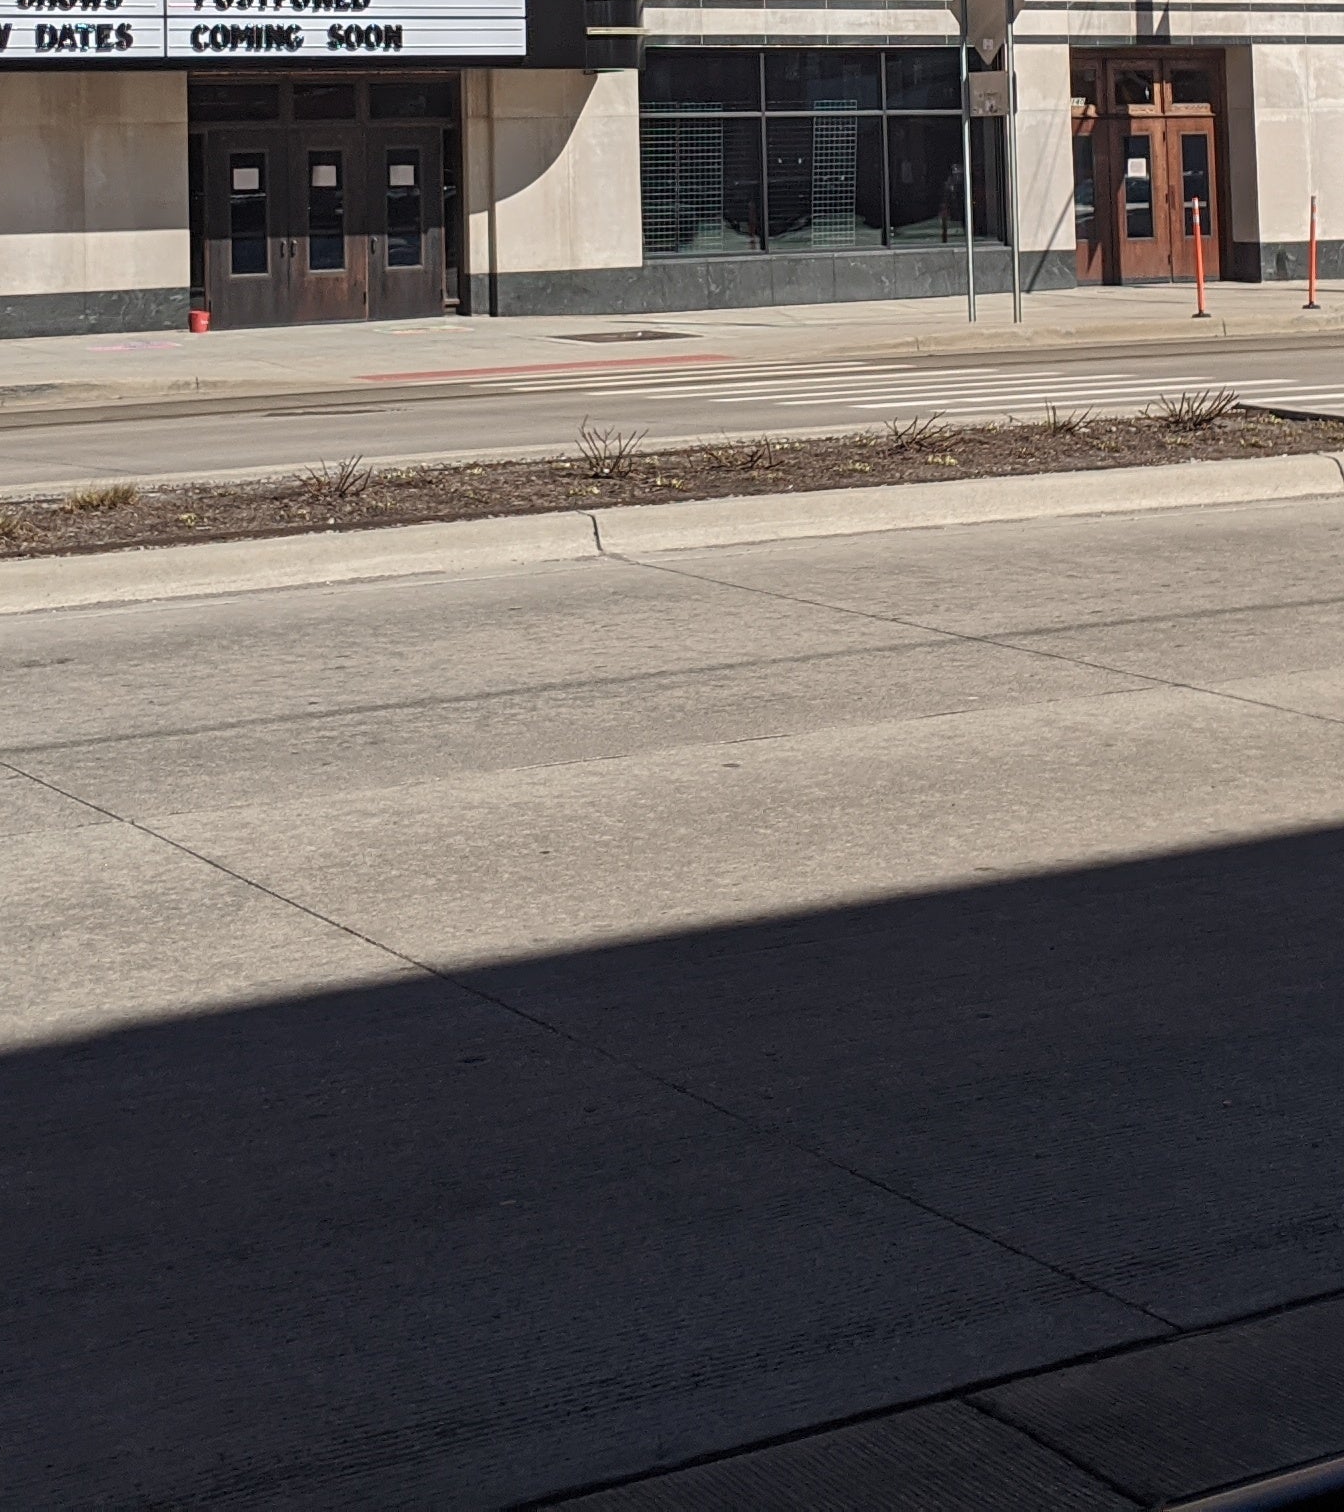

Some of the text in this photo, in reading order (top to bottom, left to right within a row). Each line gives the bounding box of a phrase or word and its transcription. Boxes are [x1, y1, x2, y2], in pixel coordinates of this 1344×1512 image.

[35, 23, 134, 53] DATES
[190, 24, 304, 52] COMING
[327, 24, 403, 51] SOON
